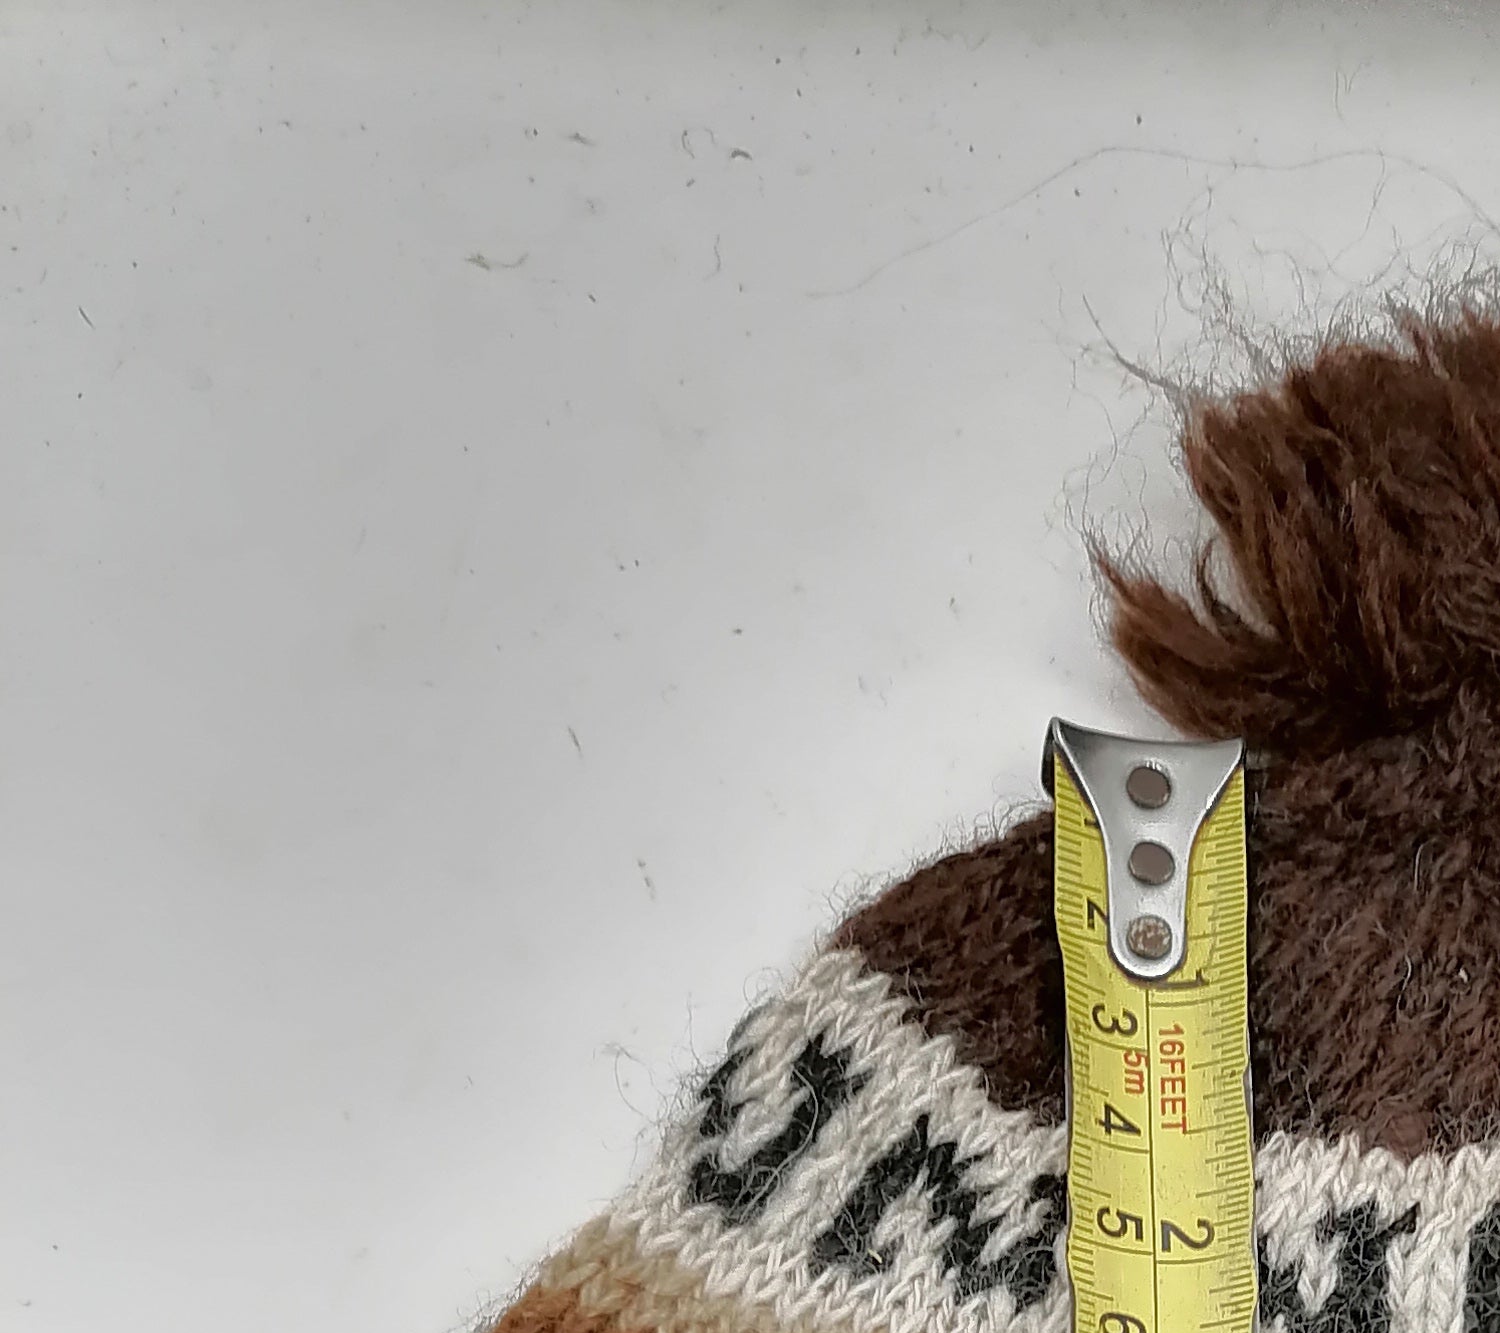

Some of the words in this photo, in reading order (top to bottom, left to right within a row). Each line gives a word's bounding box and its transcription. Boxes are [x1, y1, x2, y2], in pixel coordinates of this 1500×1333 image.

[1092, 1003, 1138, 1037] 3
[1123, 1050, 1149, 1094] 5m
[1158, 1023, 1188, 1135] 16FEET
[1095, 1101, 1141, 1136] 4
[1097, 1206, 1143, 1241] 5
[1161, 1219, 1215, 1252] 2
